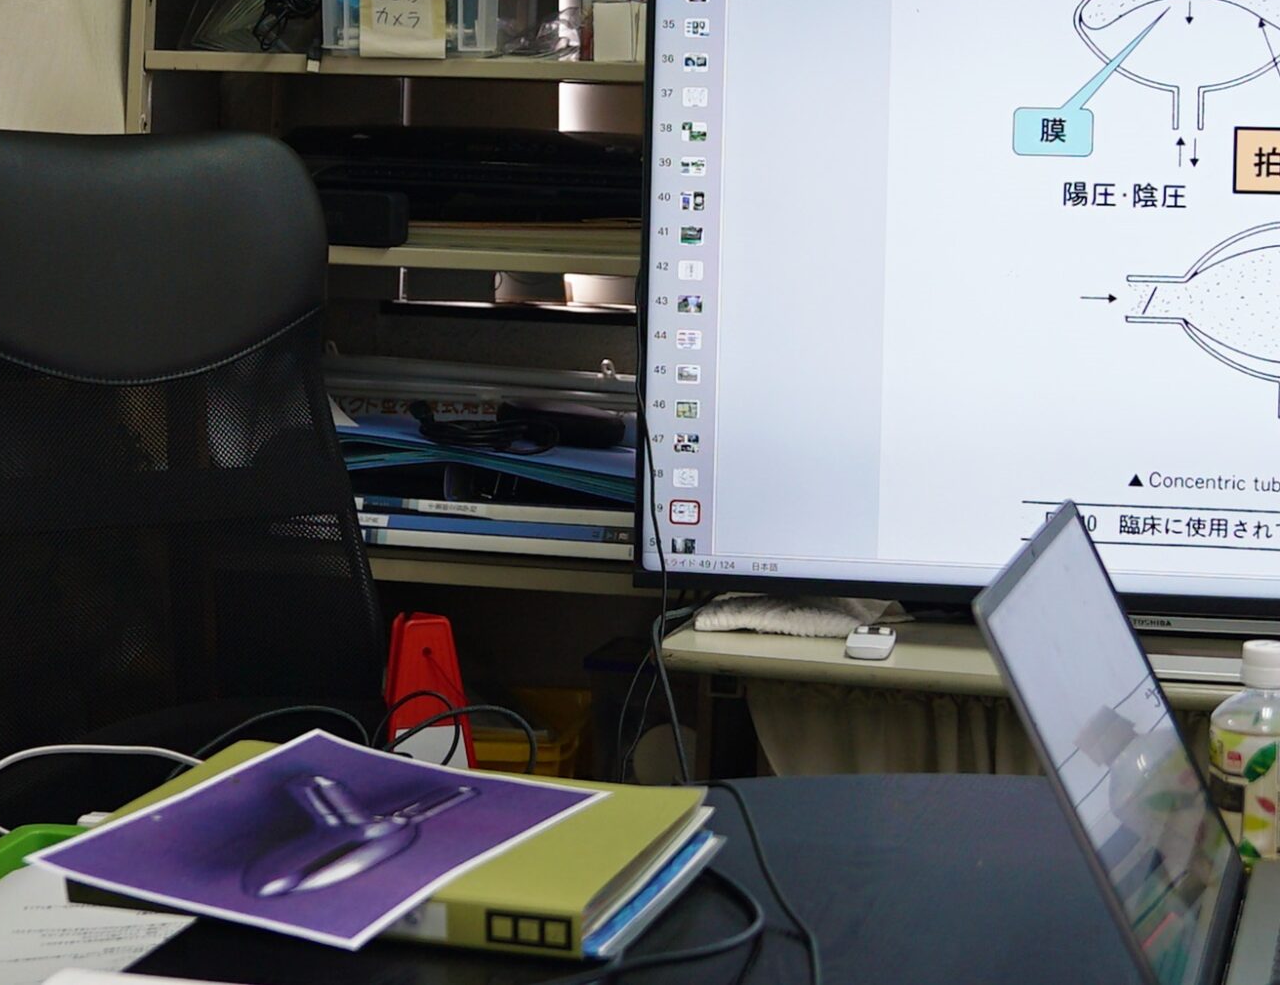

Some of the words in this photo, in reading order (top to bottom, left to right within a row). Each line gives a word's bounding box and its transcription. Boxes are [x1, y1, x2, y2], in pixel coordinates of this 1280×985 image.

[376, 7, 420, 29] カメラ
[662, 19, 675, 29] 35
[661, 54, 674, 64] 36
[660, 89, 673, 98] 37
[659, 123, 672, 133] 38
[1040, 117, 1066, 143] 膜
[659, 158, 672, 167] 39
[1254, 147, 1280, 177] 拍
[658, 192, 671, 202] 40
[657, 227, 670, 236] 41
[656, 261, 669, 271] 42
[655, 296, 668, 305] 43
[654, 330, 667, 340] 44
[653, 365, 667, 375] 45
[652, 400, 666, 409] 46
[652, 434, 665, 444] 47
[1149, 472, 1246, 491] Concentric
[699, 559, 711, 569] 49
[720, 560, 735, 570] 124
[752, 562, 778, 572] 日本語
[1133, 618, 1172, 627] TOSHIBA
